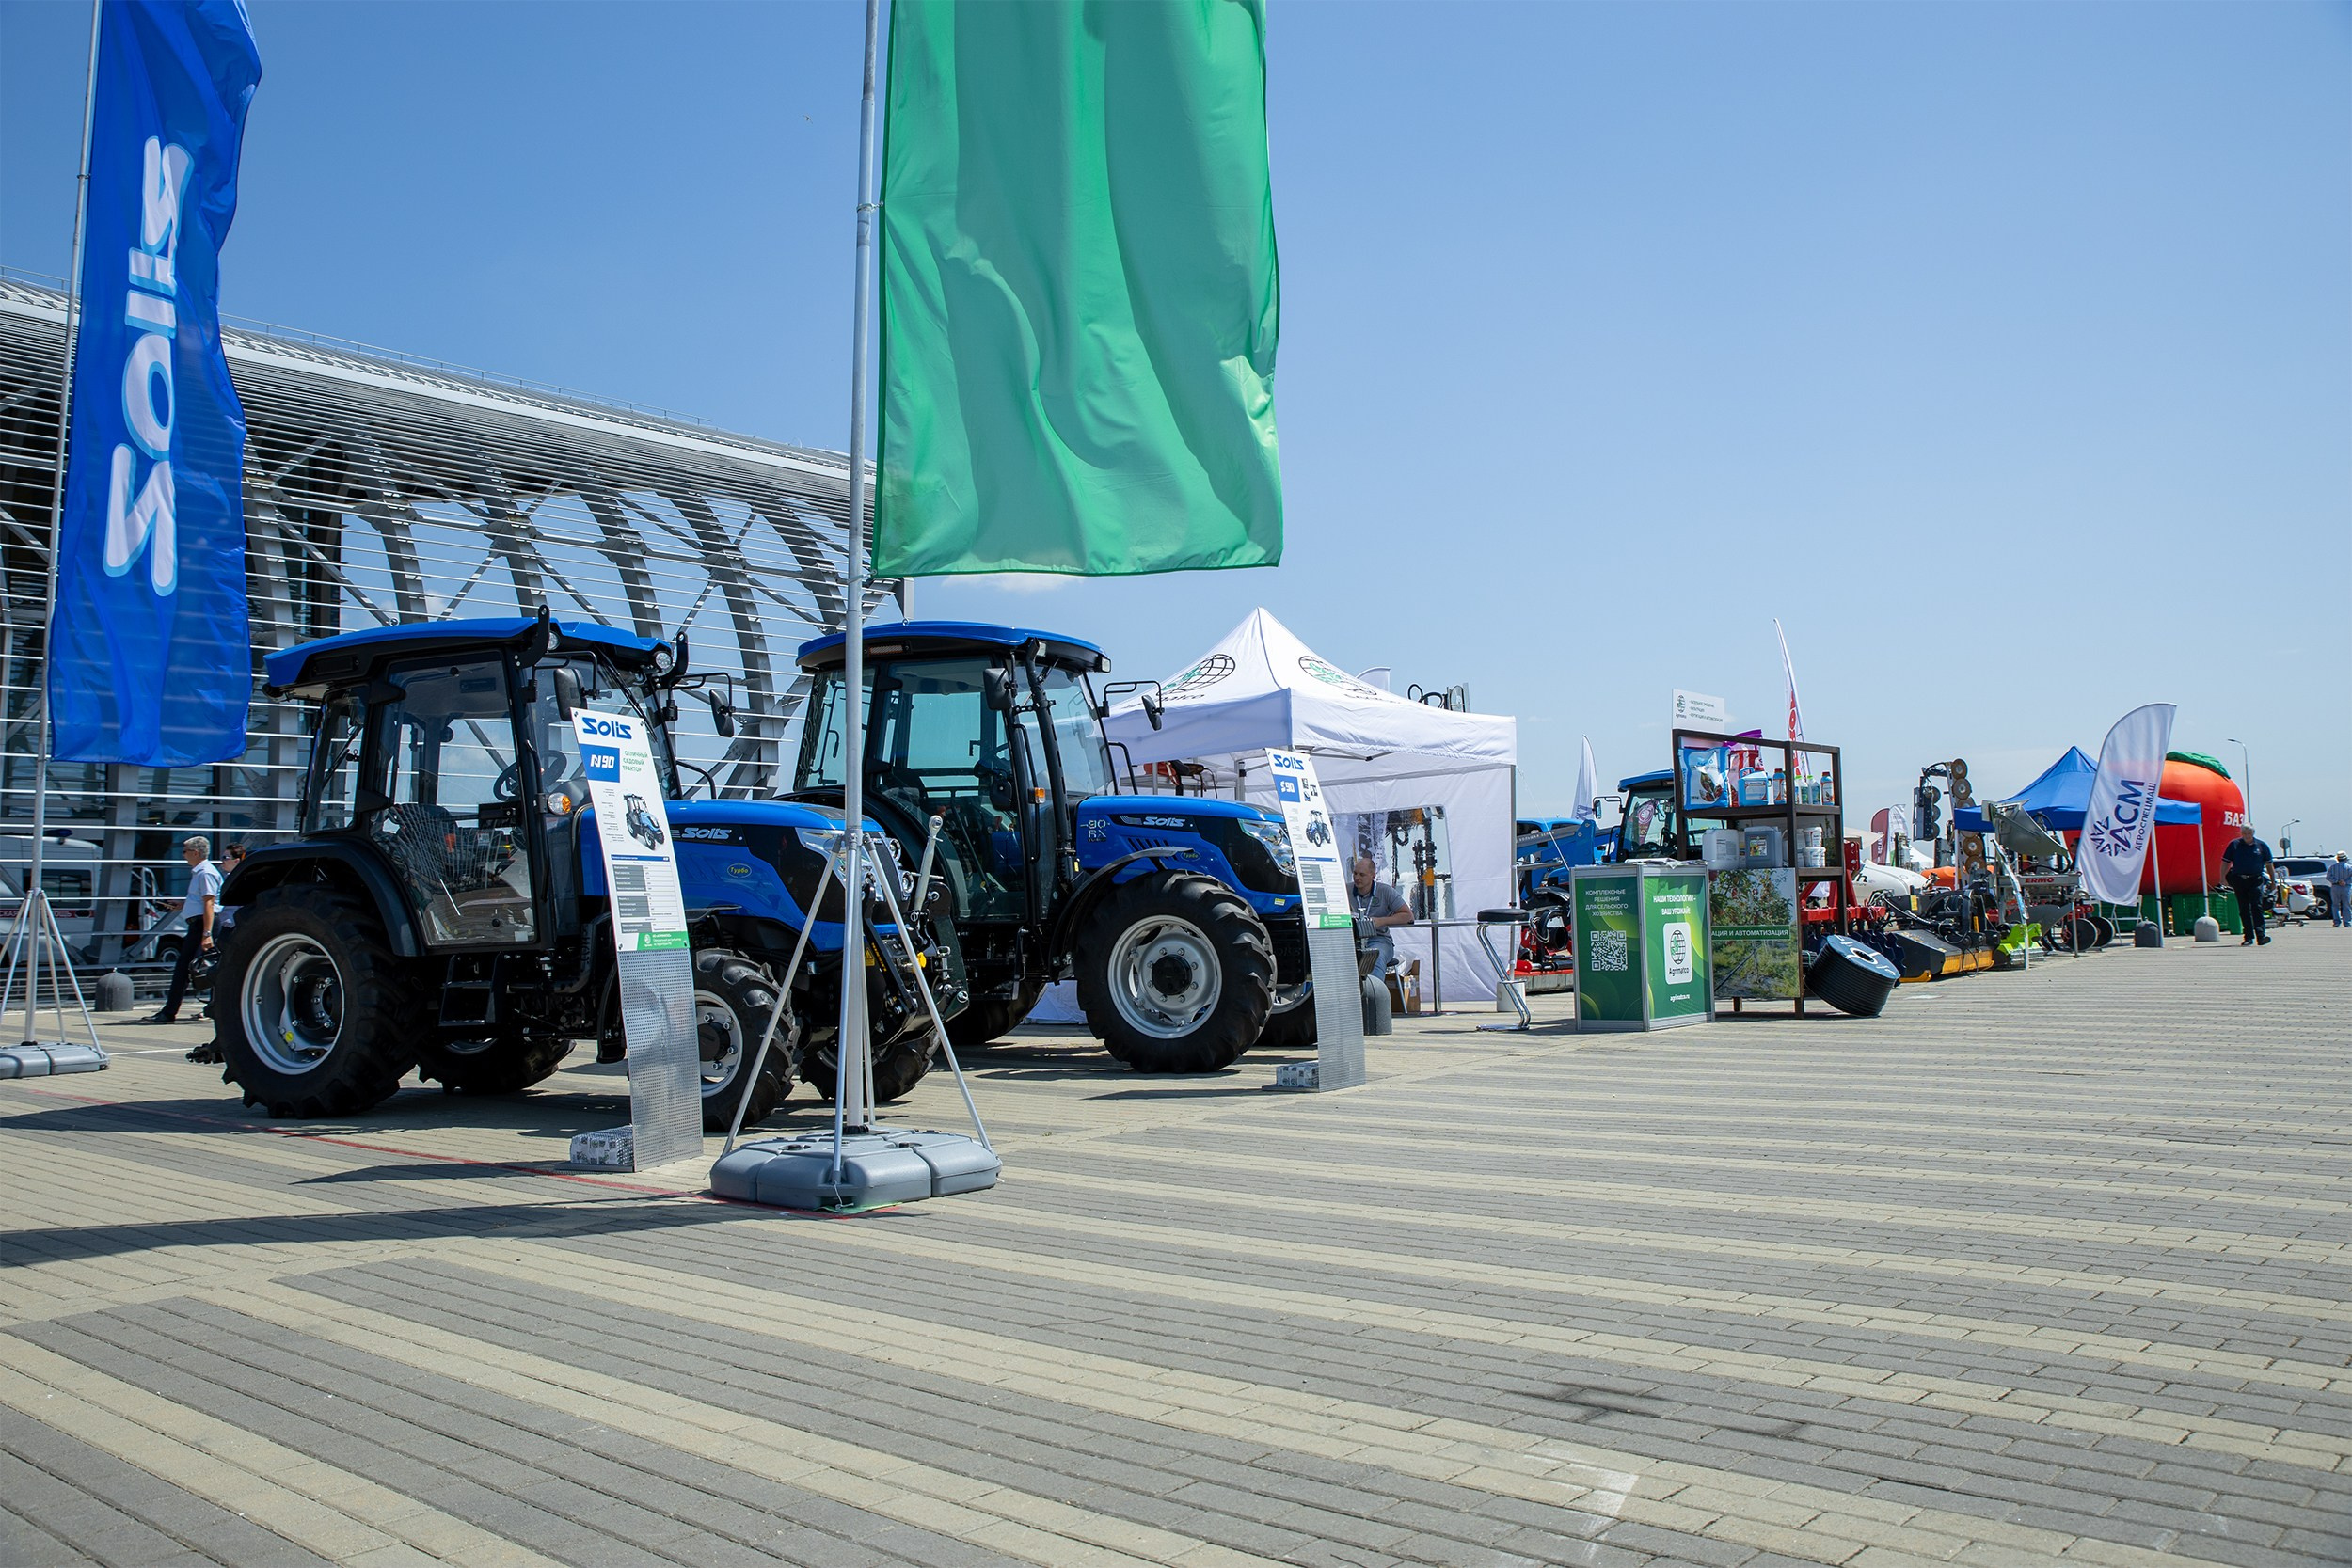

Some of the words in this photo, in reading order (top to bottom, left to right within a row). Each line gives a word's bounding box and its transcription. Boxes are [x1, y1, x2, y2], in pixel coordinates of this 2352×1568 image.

[581, 717, 632, 739] Solis
[624, 750, 648, 758] ОТЛИЧНЫЙ
[1273, 754, 1305, 770] Solis
[622, 765, 642, 773] ТРАКТОР
[1143, 816, 1185, 827] Solis
[2135, 783, 2156, 851] АГРОСПЕЦМАШ
[681, 827, 732, 840] Solis
[1668, 966, 1690, 976] Agrimatco
